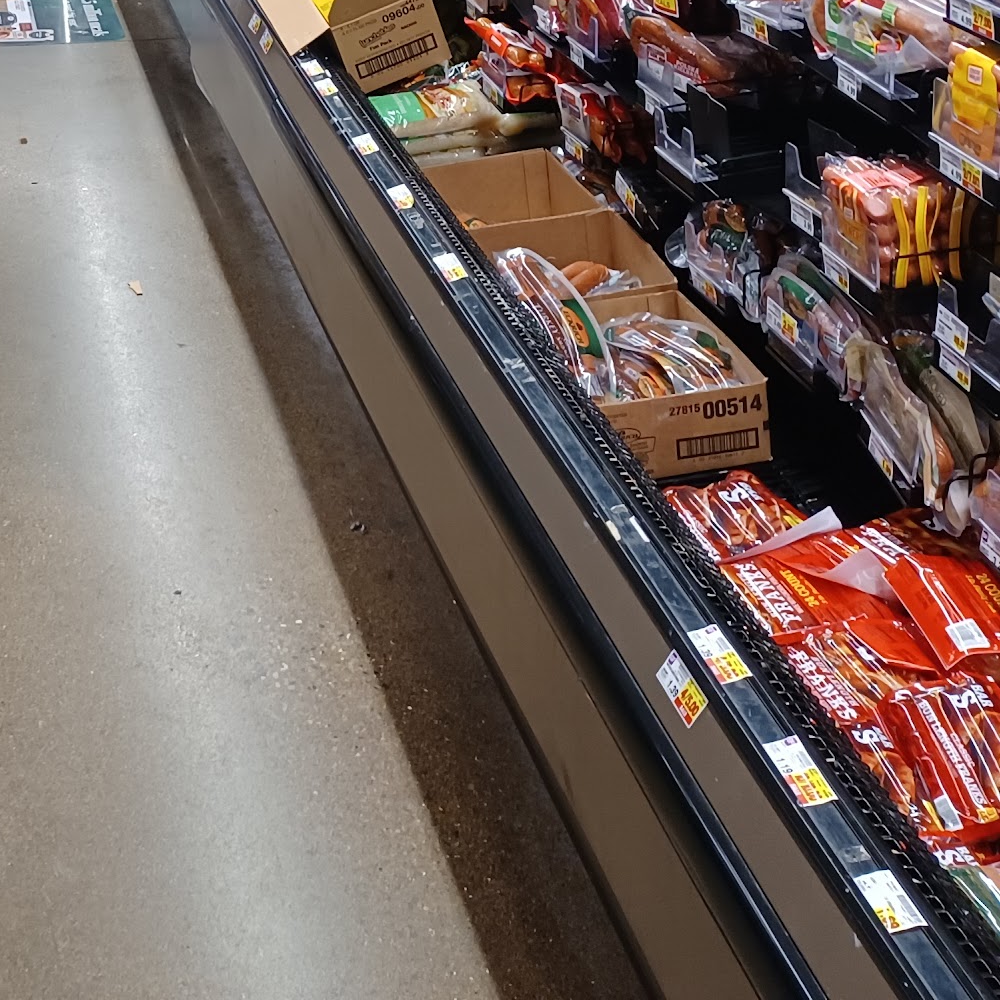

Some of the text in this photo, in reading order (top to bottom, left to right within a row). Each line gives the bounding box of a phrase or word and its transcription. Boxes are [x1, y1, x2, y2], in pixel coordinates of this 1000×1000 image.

[382, 3, 416, 23] 09604
[669, 394, 763, 419] 27815 00514
[780, 570, 820, 607] 24 COUNT
[975, 573, 991, 584] 24
[740, 562, 803, 628] FRANKS
[787, 646, 859, 720] FRANKS
[681, 688, 700, 717] 4/5.00
